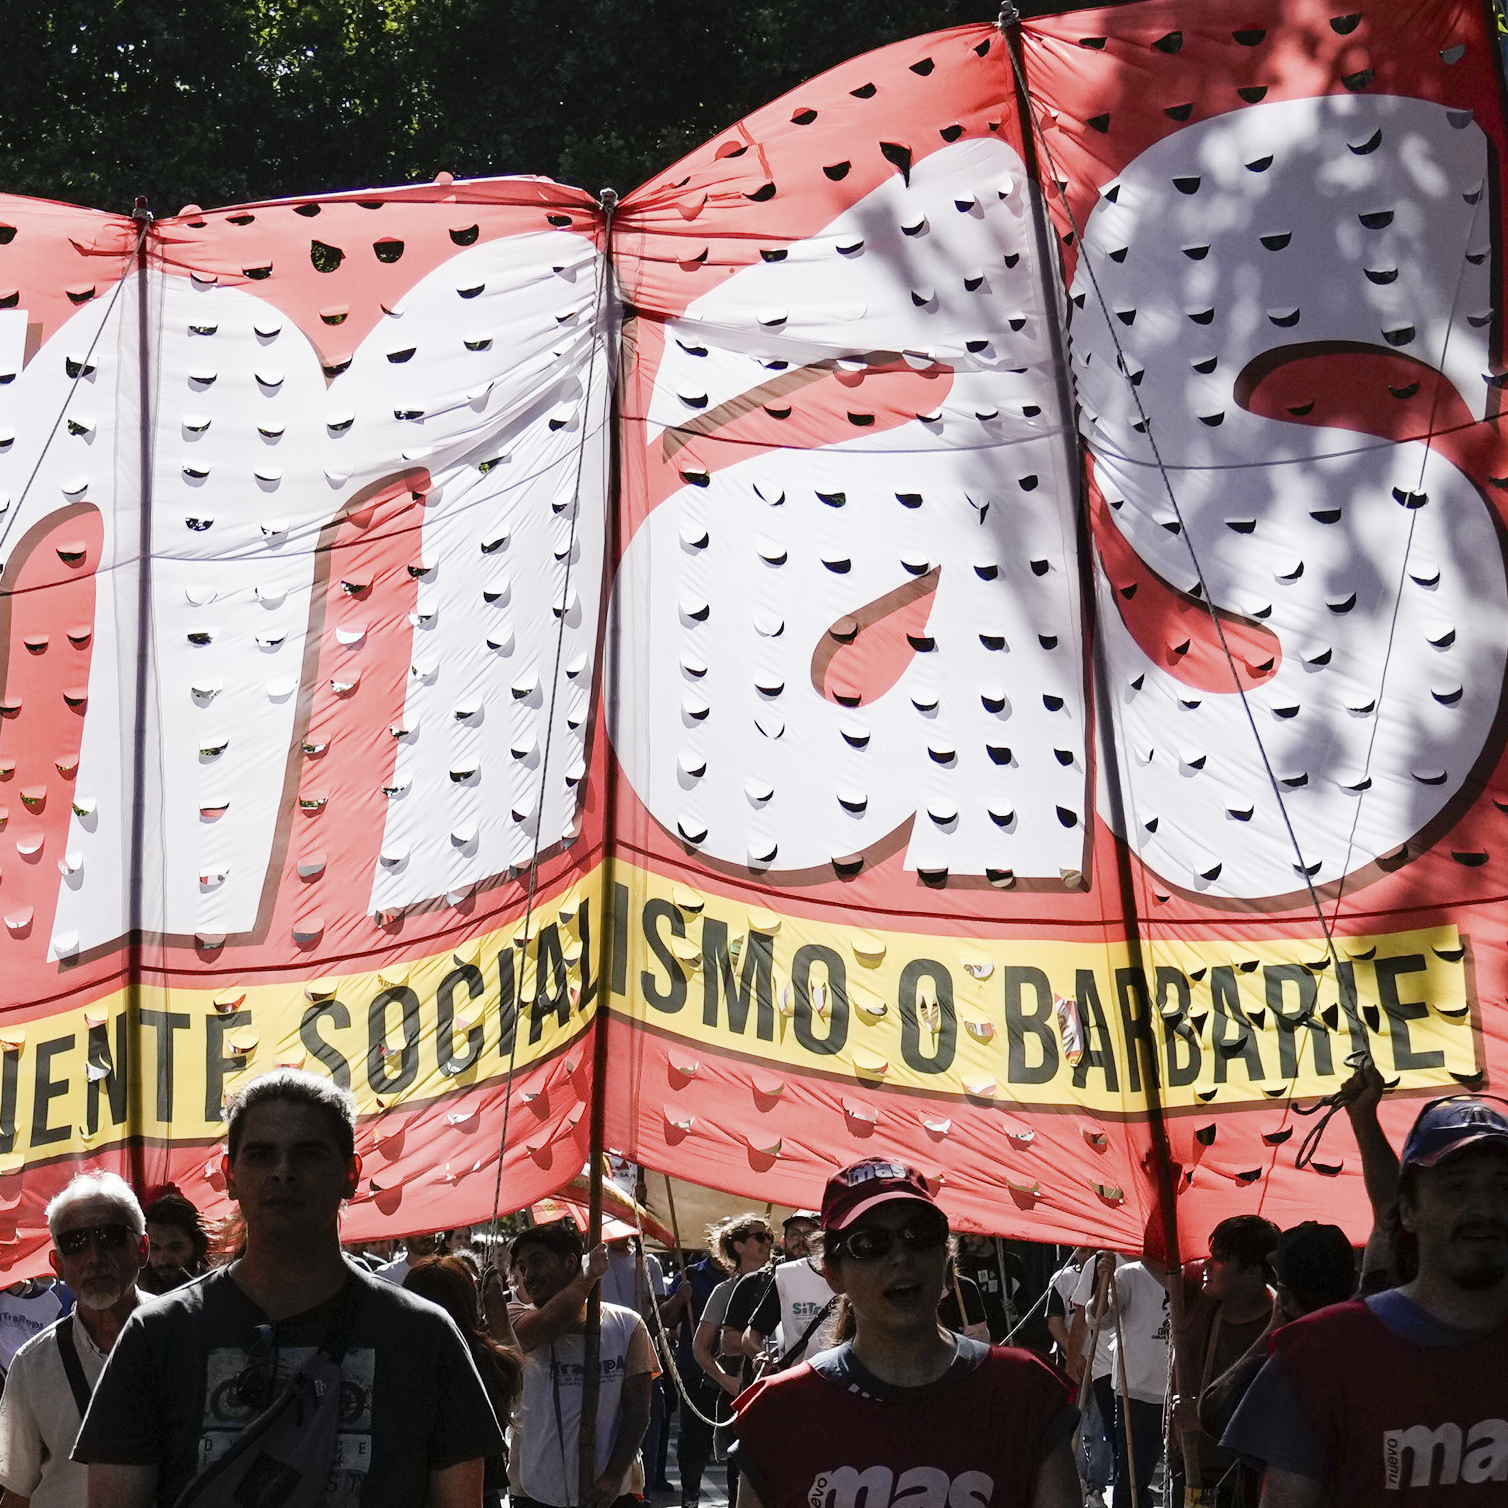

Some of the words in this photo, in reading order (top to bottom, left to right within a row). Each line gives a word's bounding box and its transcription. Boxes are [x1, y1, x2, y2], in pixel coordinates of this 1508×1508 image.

[299, 882, 849, 1094] SOCIALISMO
[898, 958, 954, 1075] O
[1005, 955, 1445, 1094] BARBARIE
[846, 1163, 907, 1187] mas
[1387, 1438, 1400, 1485] nuevo
